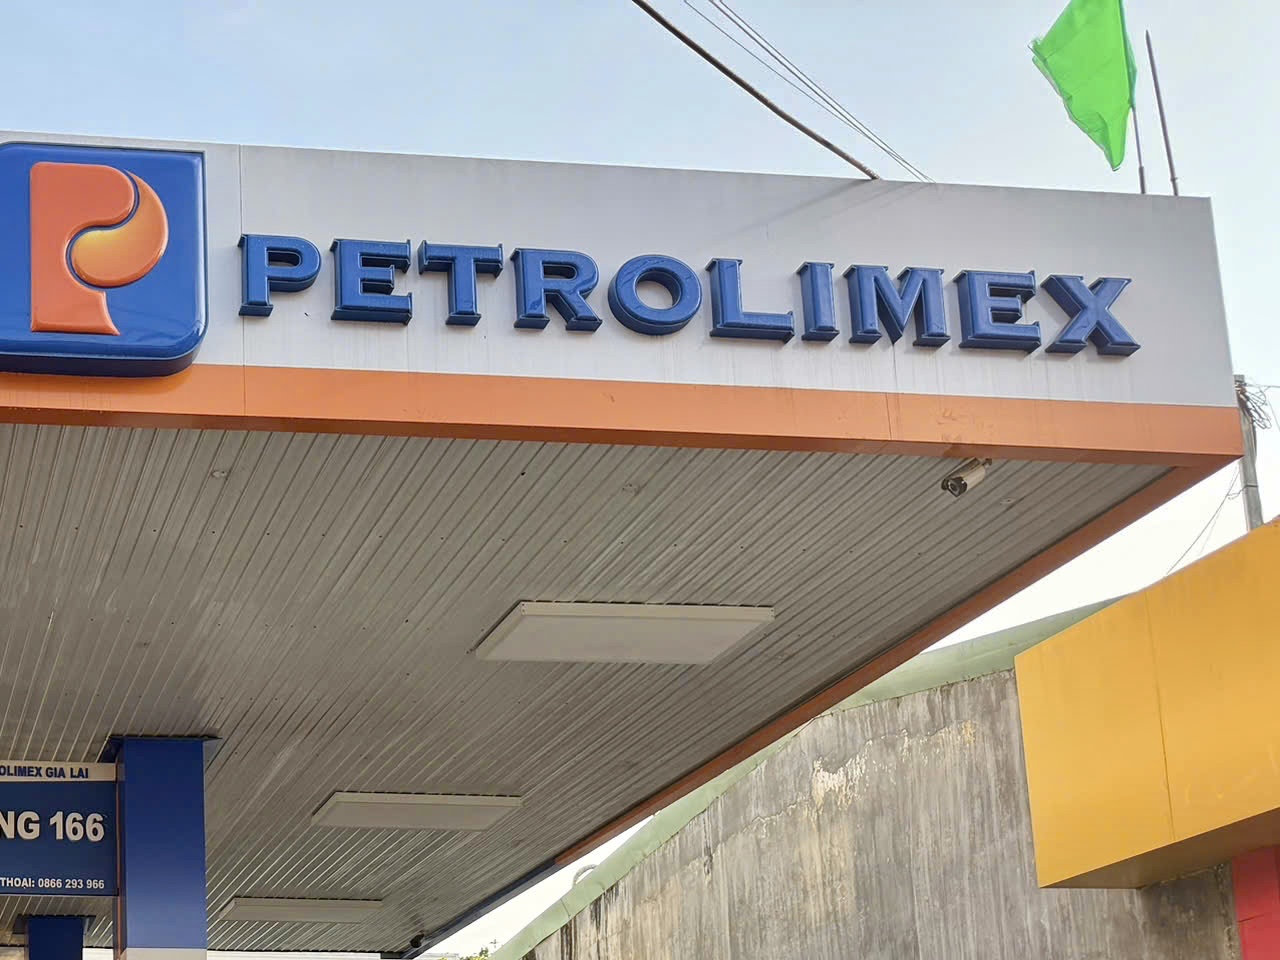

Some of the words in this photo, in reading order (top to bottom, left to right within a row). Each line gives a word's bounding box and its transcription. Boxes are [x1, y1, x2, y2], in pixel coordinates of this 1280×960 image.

[238, 233, 1138, 356] PETROLIMEX
[45, 767, 66, 778] GIA
[70, 767, 89, 779] LAI
[49, 811, 106, 842] 166
[0, 876, 35, 889] THOẠI:
[38, 877, 62, 889] 0866
[65, 878, 83, 889] 293
[86, 878, 105, 890] 966
